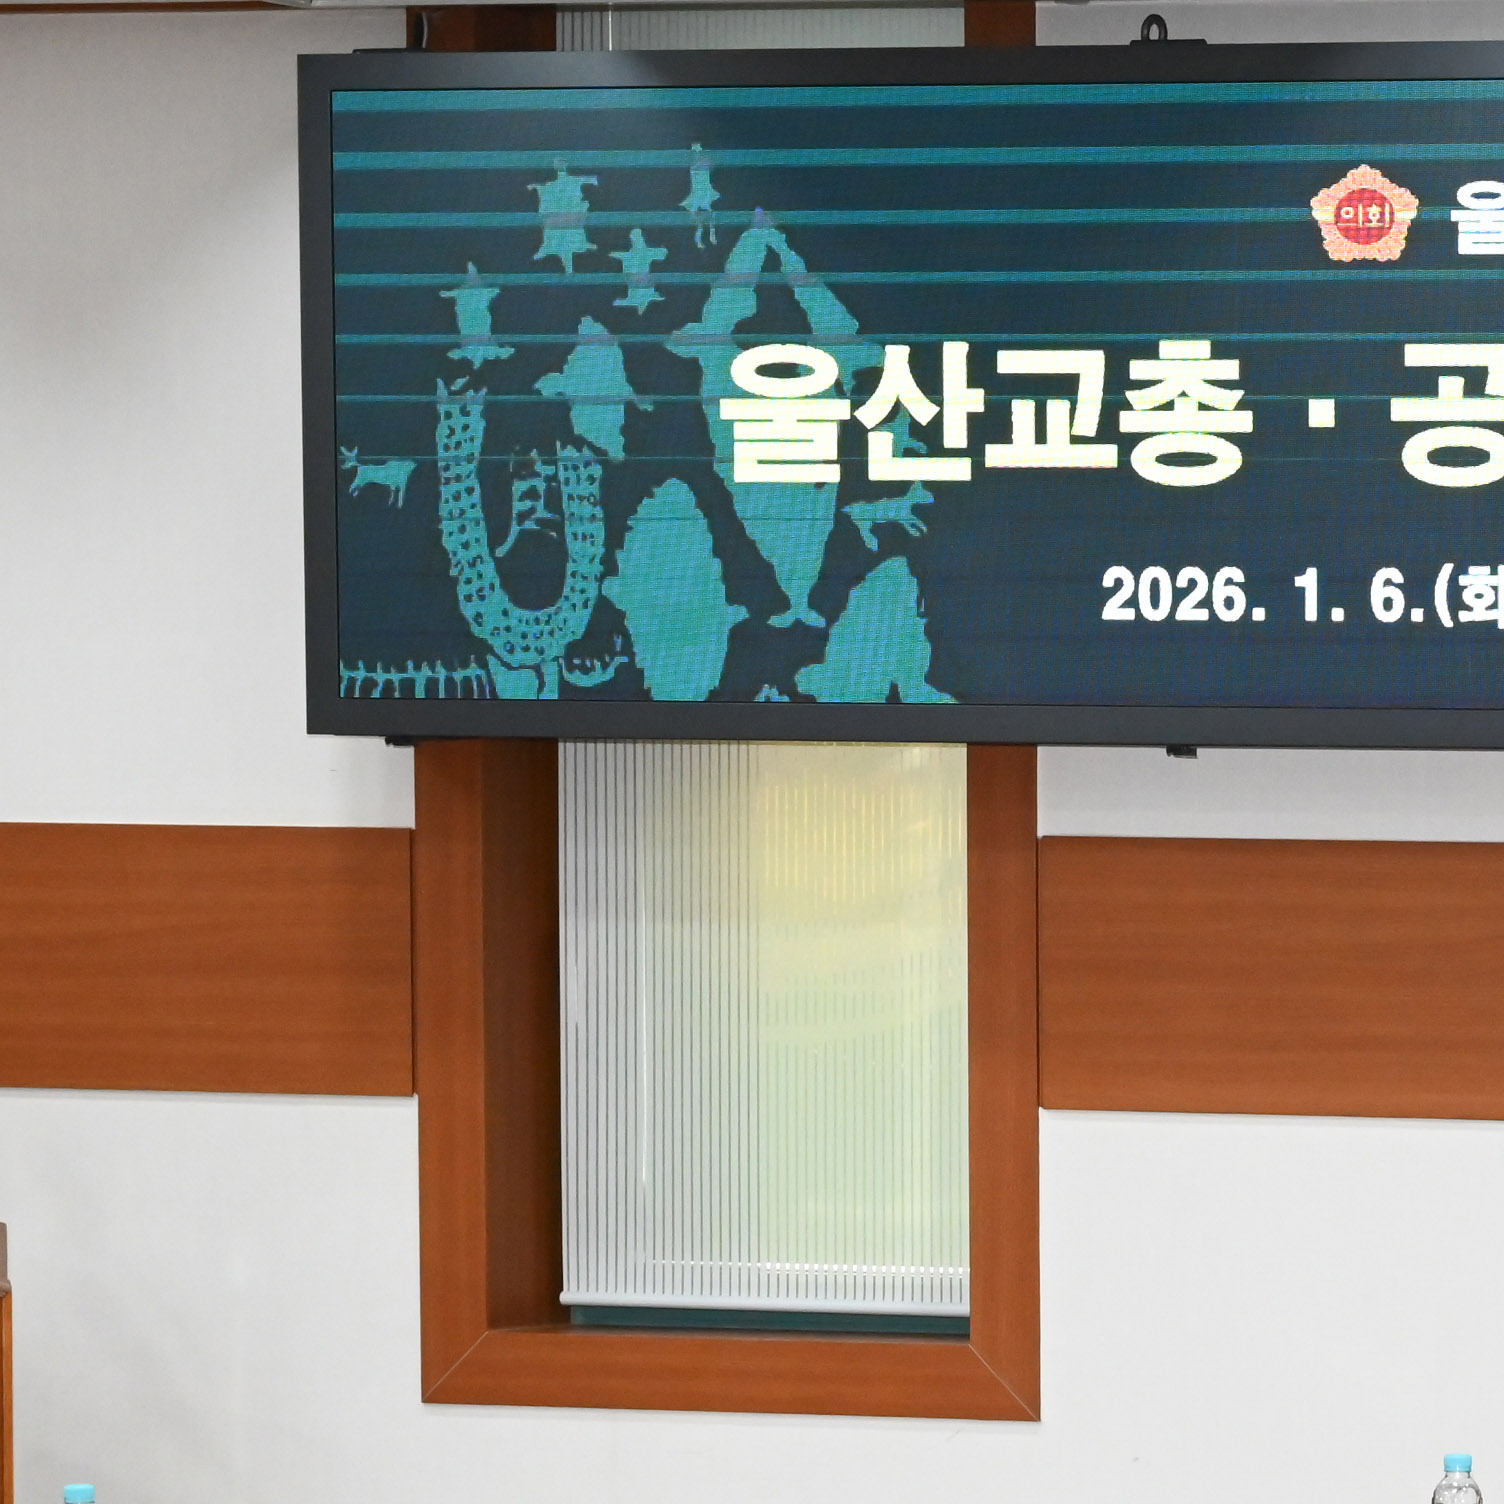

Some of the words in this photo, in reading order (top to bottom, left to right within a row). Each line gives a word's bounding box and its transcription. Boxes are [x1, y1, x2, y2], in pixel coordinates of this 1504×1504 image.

[1337, 202, 1392, 229] 의회
[718, 338, 1254, 488] 울산교총
[1100, 564, 1266, 623] 2026.
[1293, 566, 1345, 623] 1.
